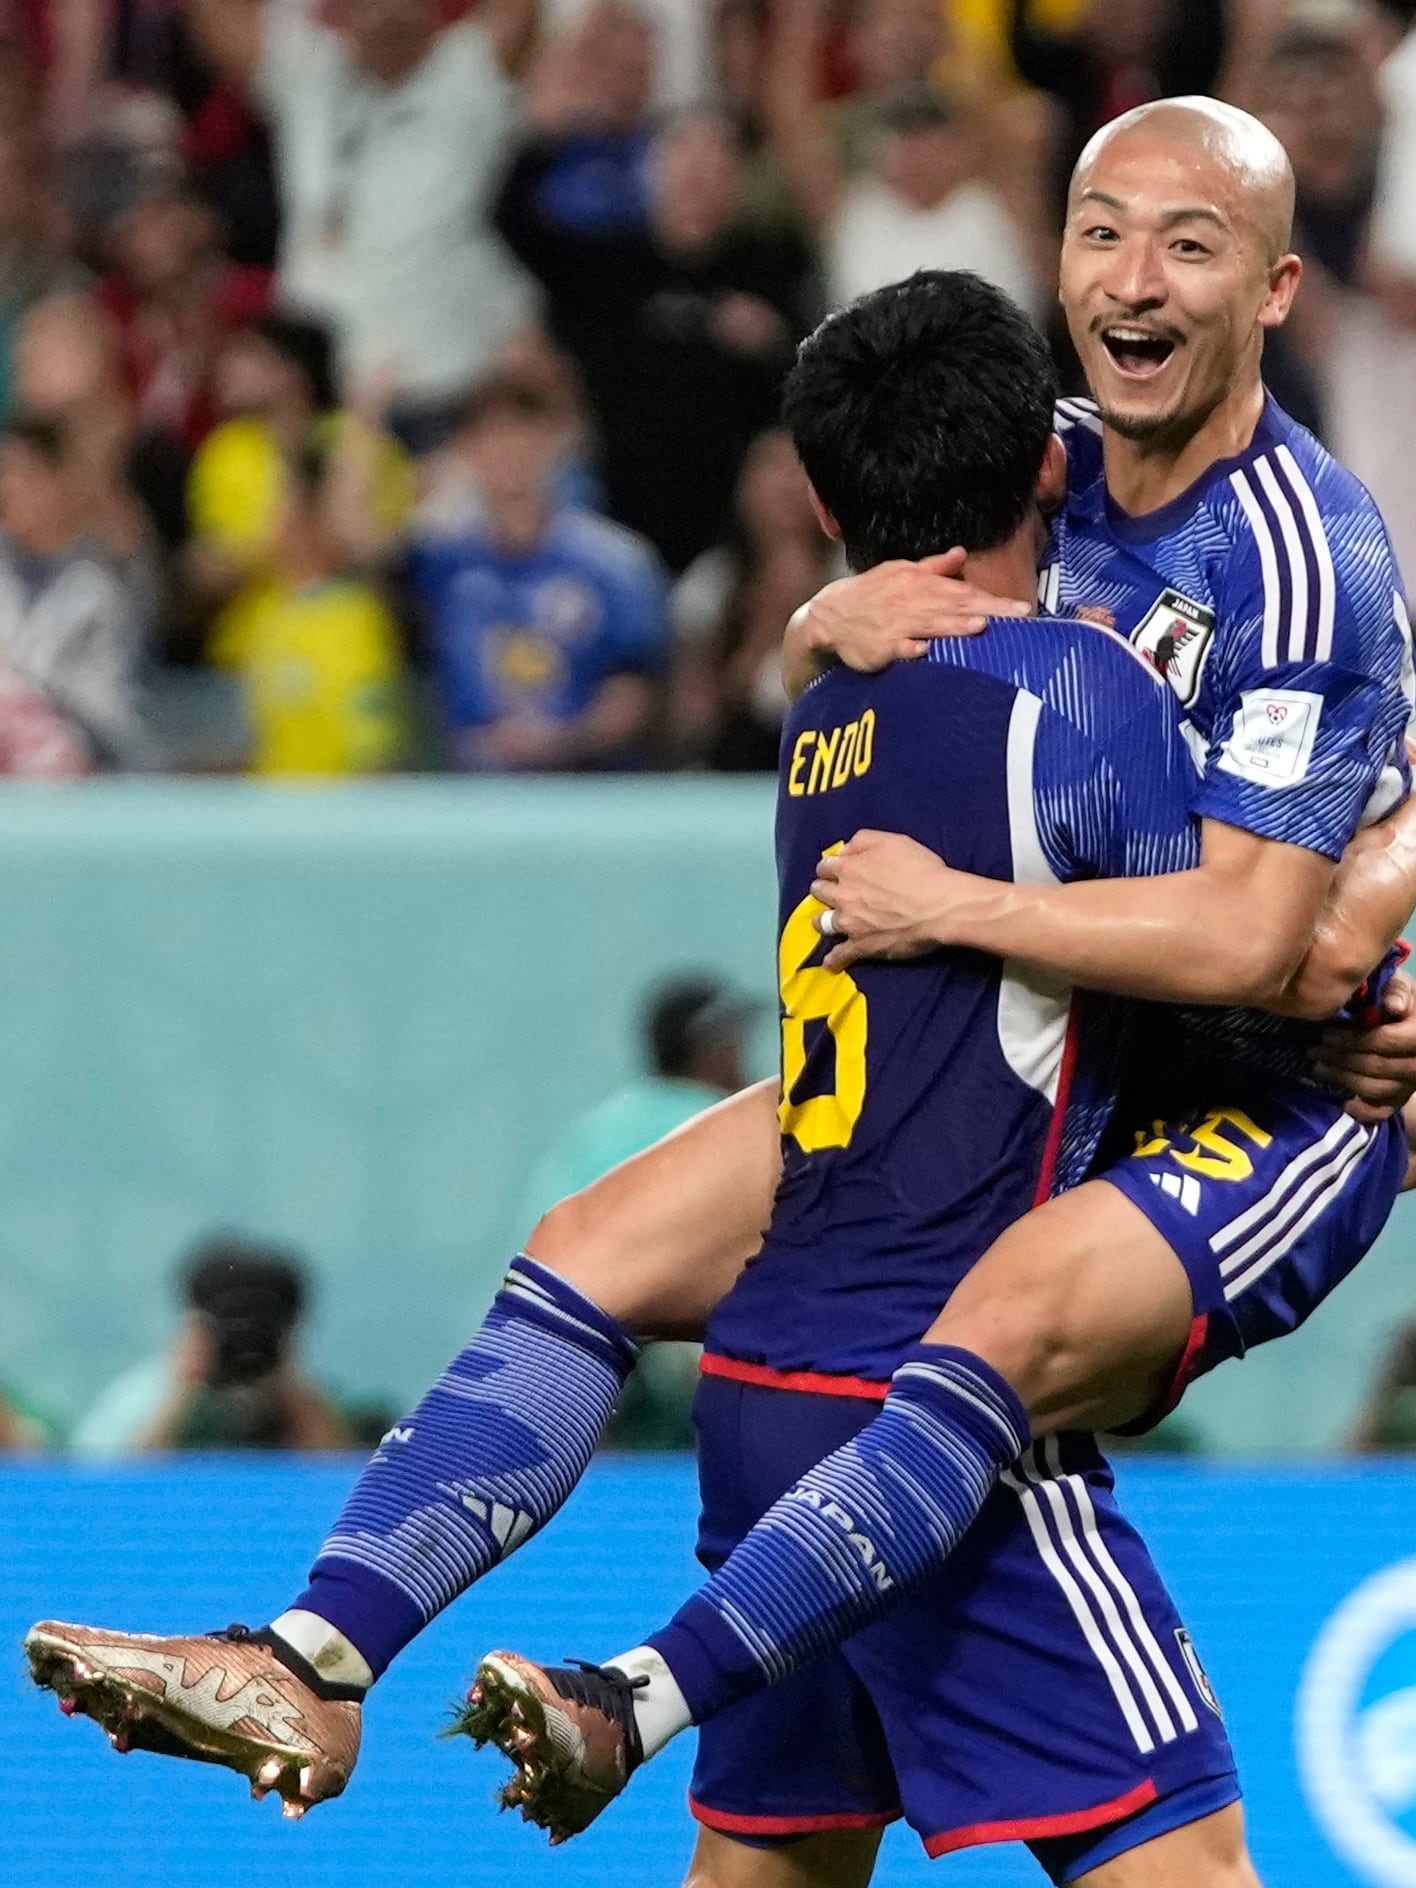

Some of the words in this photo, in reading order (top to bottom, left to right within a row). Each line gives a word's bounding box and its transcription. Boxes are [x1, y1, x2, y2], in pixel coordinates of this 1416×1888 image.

[1171, 598, 1200, 619] JAPAN
[788, 708, 876, 797] ENDO
[777, 840, 867, 1153] 6
[783, 1487, 896, 1591] JAPAN
